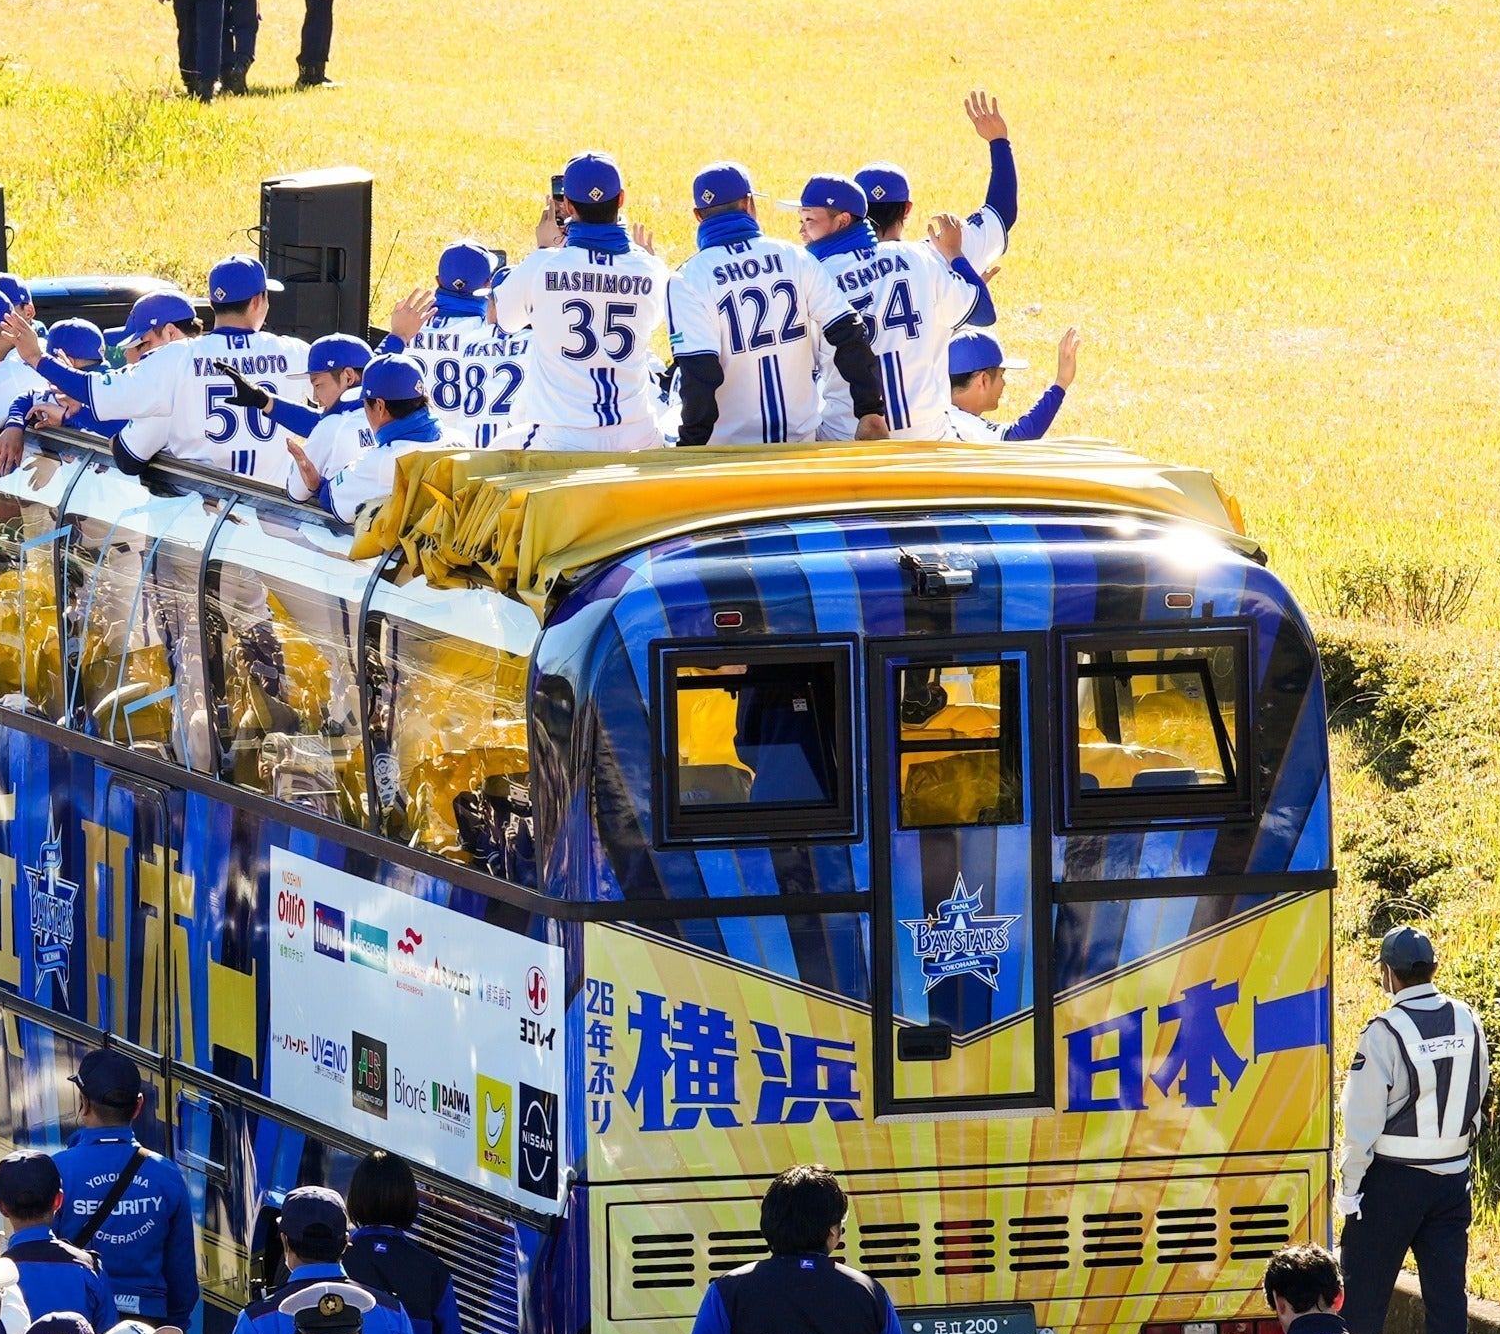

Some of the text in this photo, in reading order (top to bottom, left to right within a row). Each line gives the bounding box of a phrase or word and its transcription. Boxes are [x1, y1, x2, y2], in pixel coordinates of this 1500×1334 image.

[545, 270, 653, 296] HASHIMOTO
[711, 253, 785, 286] SHOJI
[561, 298, 639, 363] 35
[716, 279, 808, 356] 122
[193, 354, 288, 378] YAAMOTO
[463, 359, 525, 418] 82
[950, 900, 970, 913] DeNA
[353, 931, 387, 963] Hisense
[912, 920, 1009, 957] BAYSTARS
[939, 959, 981, 974] YOKOHAMA
[519, 1017, 557, 1052] ヨコレイ
[311, 1033, 349, 1074] UYENO
[585, 977, 615, 1135] 26年ぶり
[622, 975, 1329, 1133] 横浜 日本一
[394, 1067, 427, 1115] Bioré
[442, 1080, 471, 1115] DAIWA
[521, 1129, 553, 1154] NISSAN
[85, 1171, 149, 1190] YOKOMA
